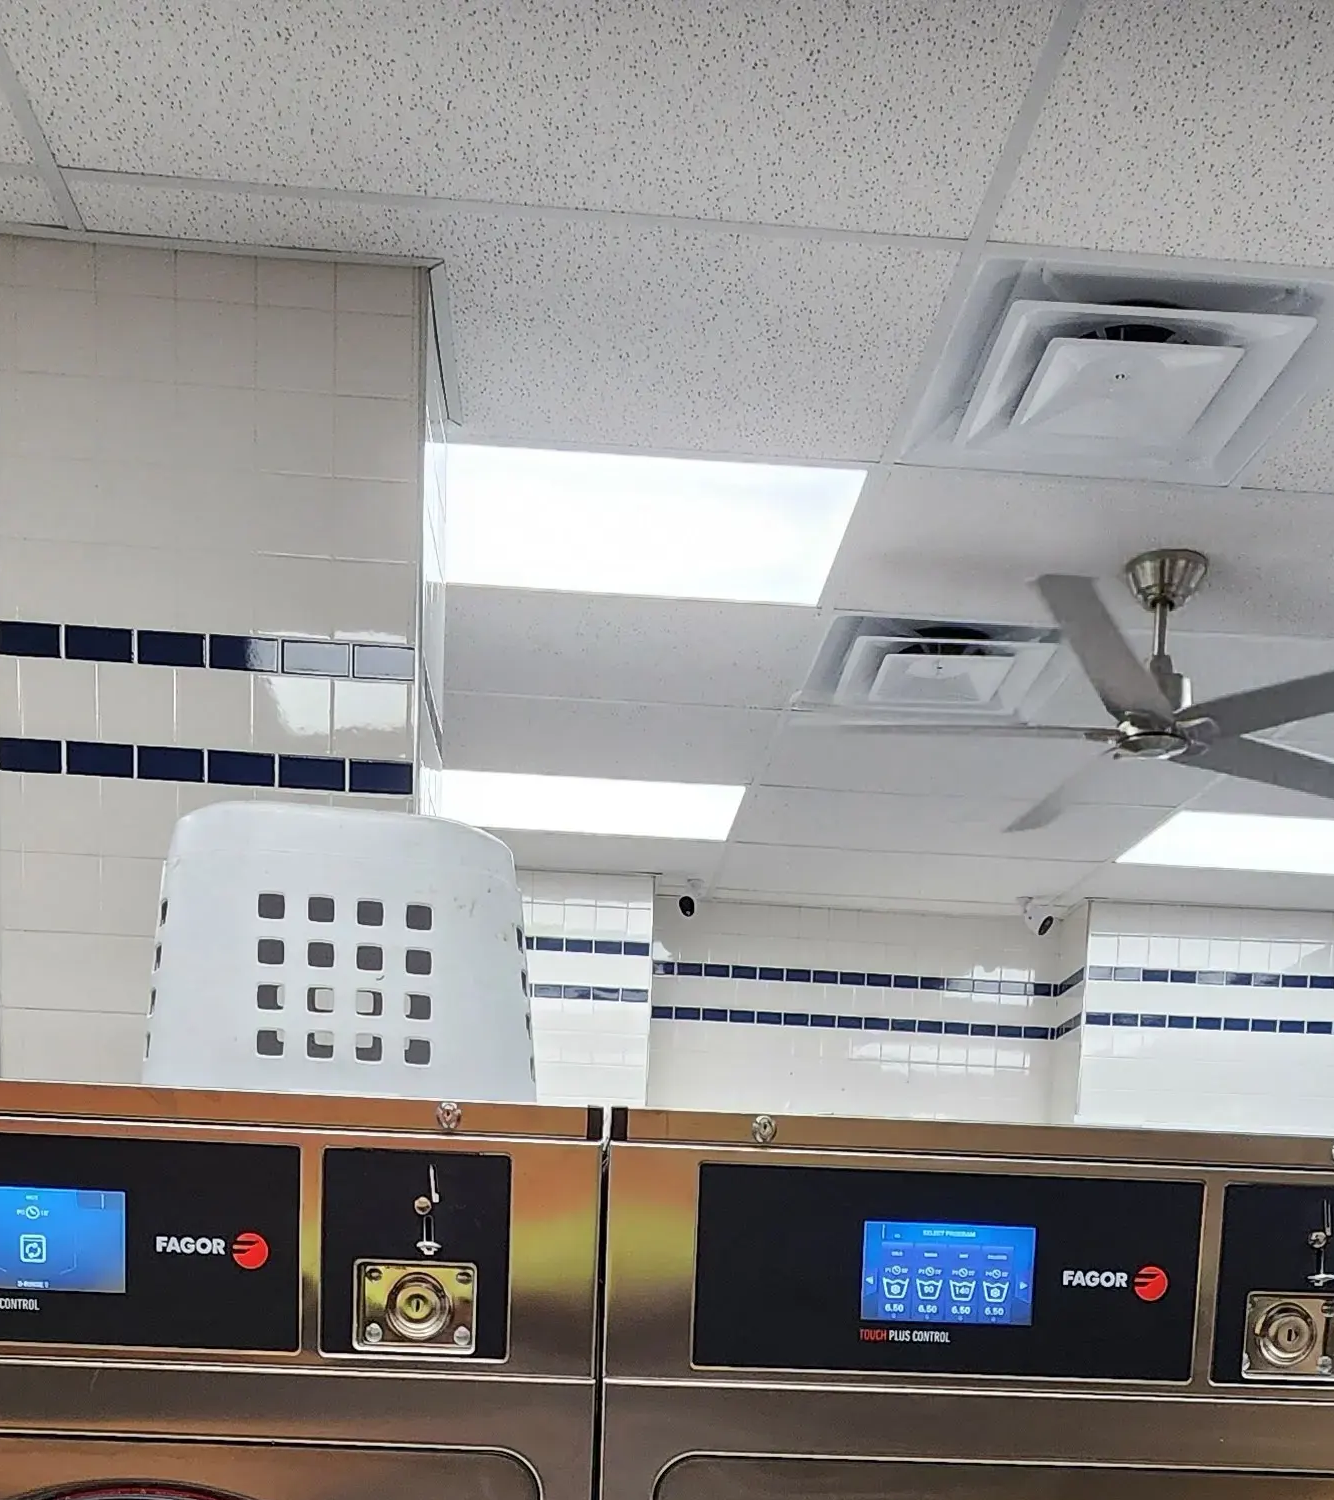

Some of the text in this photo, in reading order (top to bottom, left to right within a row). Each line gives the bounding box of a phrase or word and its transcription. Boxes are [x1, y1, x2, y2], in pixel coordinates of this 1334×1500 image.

[155, 1236, 226, 1256] FAGOR
[1062, 1270, 1128, 1288] FAGOR
[0, 1298, 41, 1312] CONTROL
[859, 1328, 951, 1343] TOUCH PLUS CONTROL
